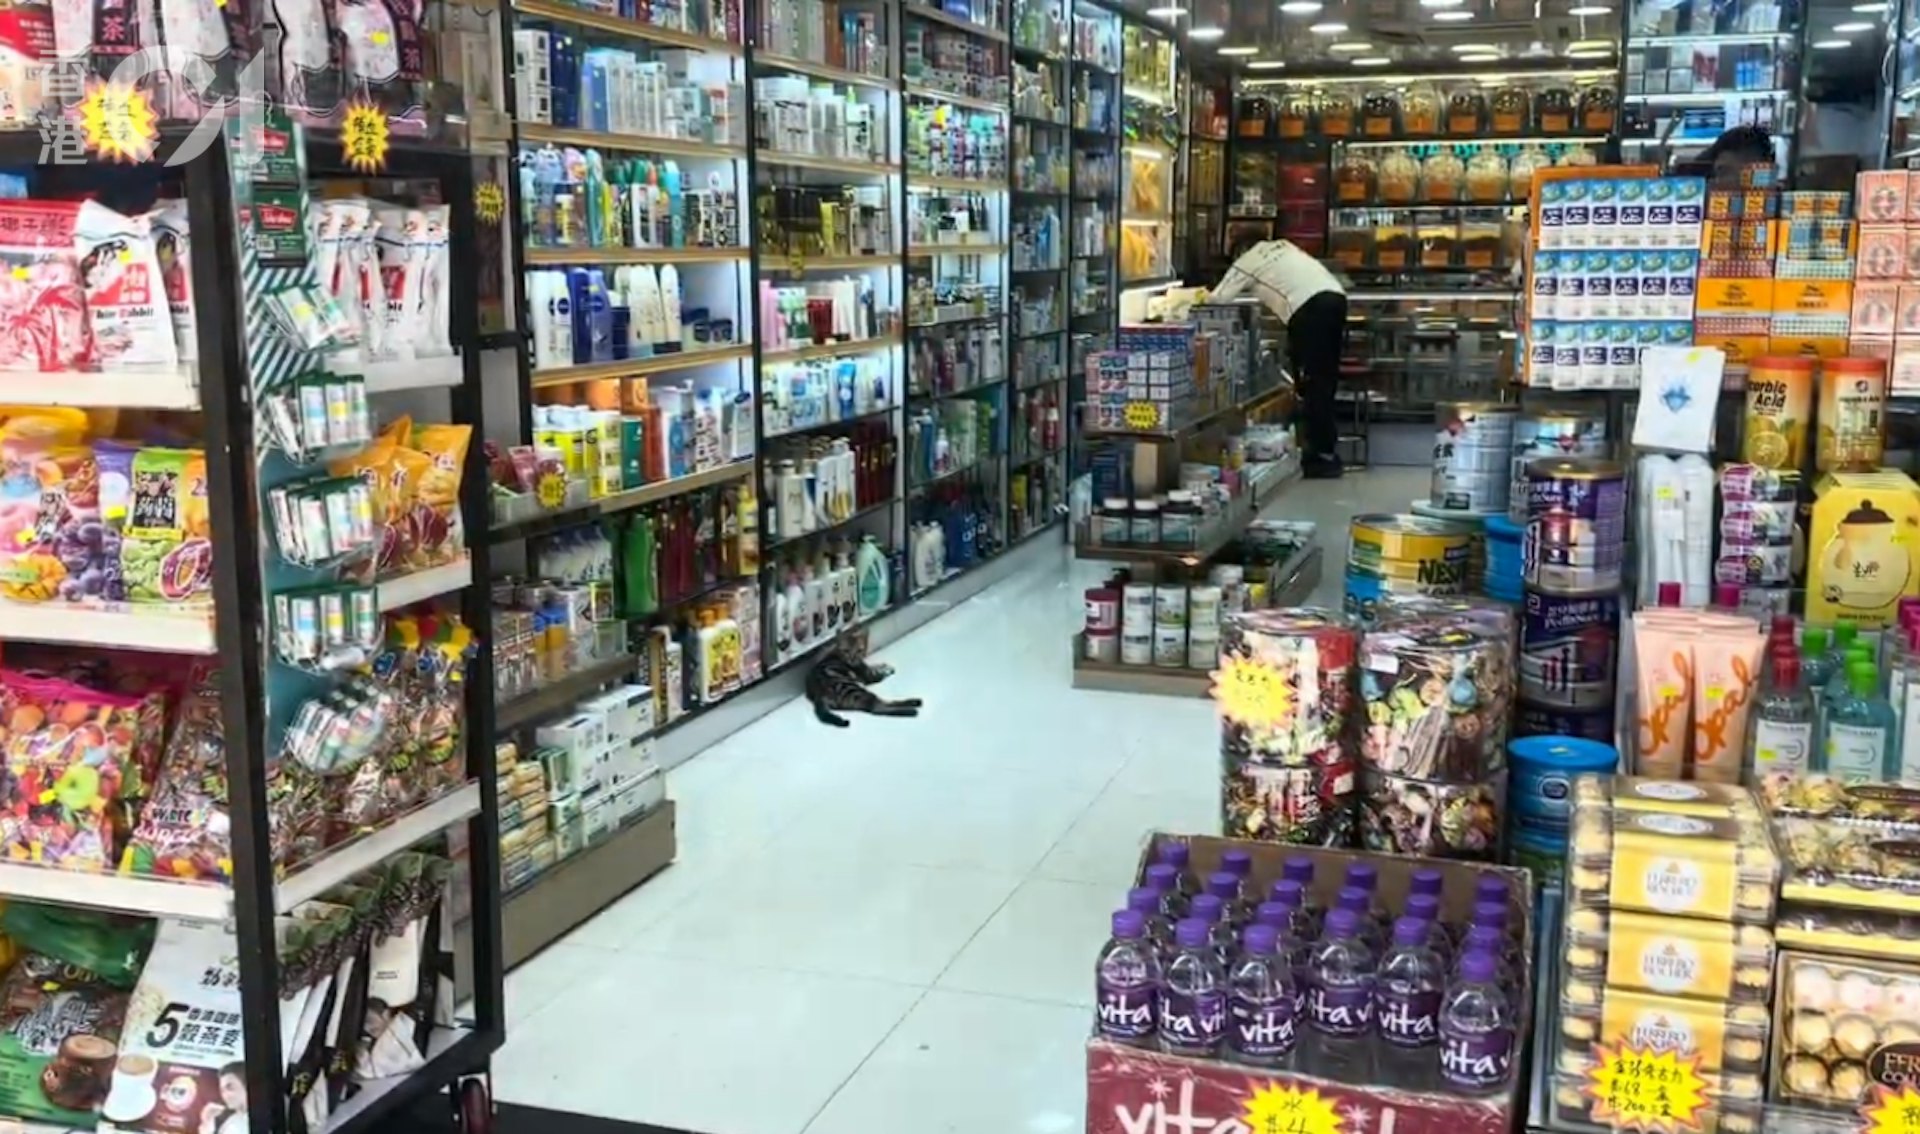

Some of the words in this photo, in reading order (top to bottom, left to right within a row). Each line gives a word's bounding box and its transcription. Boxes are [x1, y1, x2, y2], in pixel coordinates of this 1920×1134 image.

[1755, 393, 1787, 408] Acid
[1099, 994, 1152, 1024] vita
[1379, 1000, 1434, 1034] vita
[1239, 1012, 1294, 1042] vita
[1440, 1039, 1496, 1074] vita
